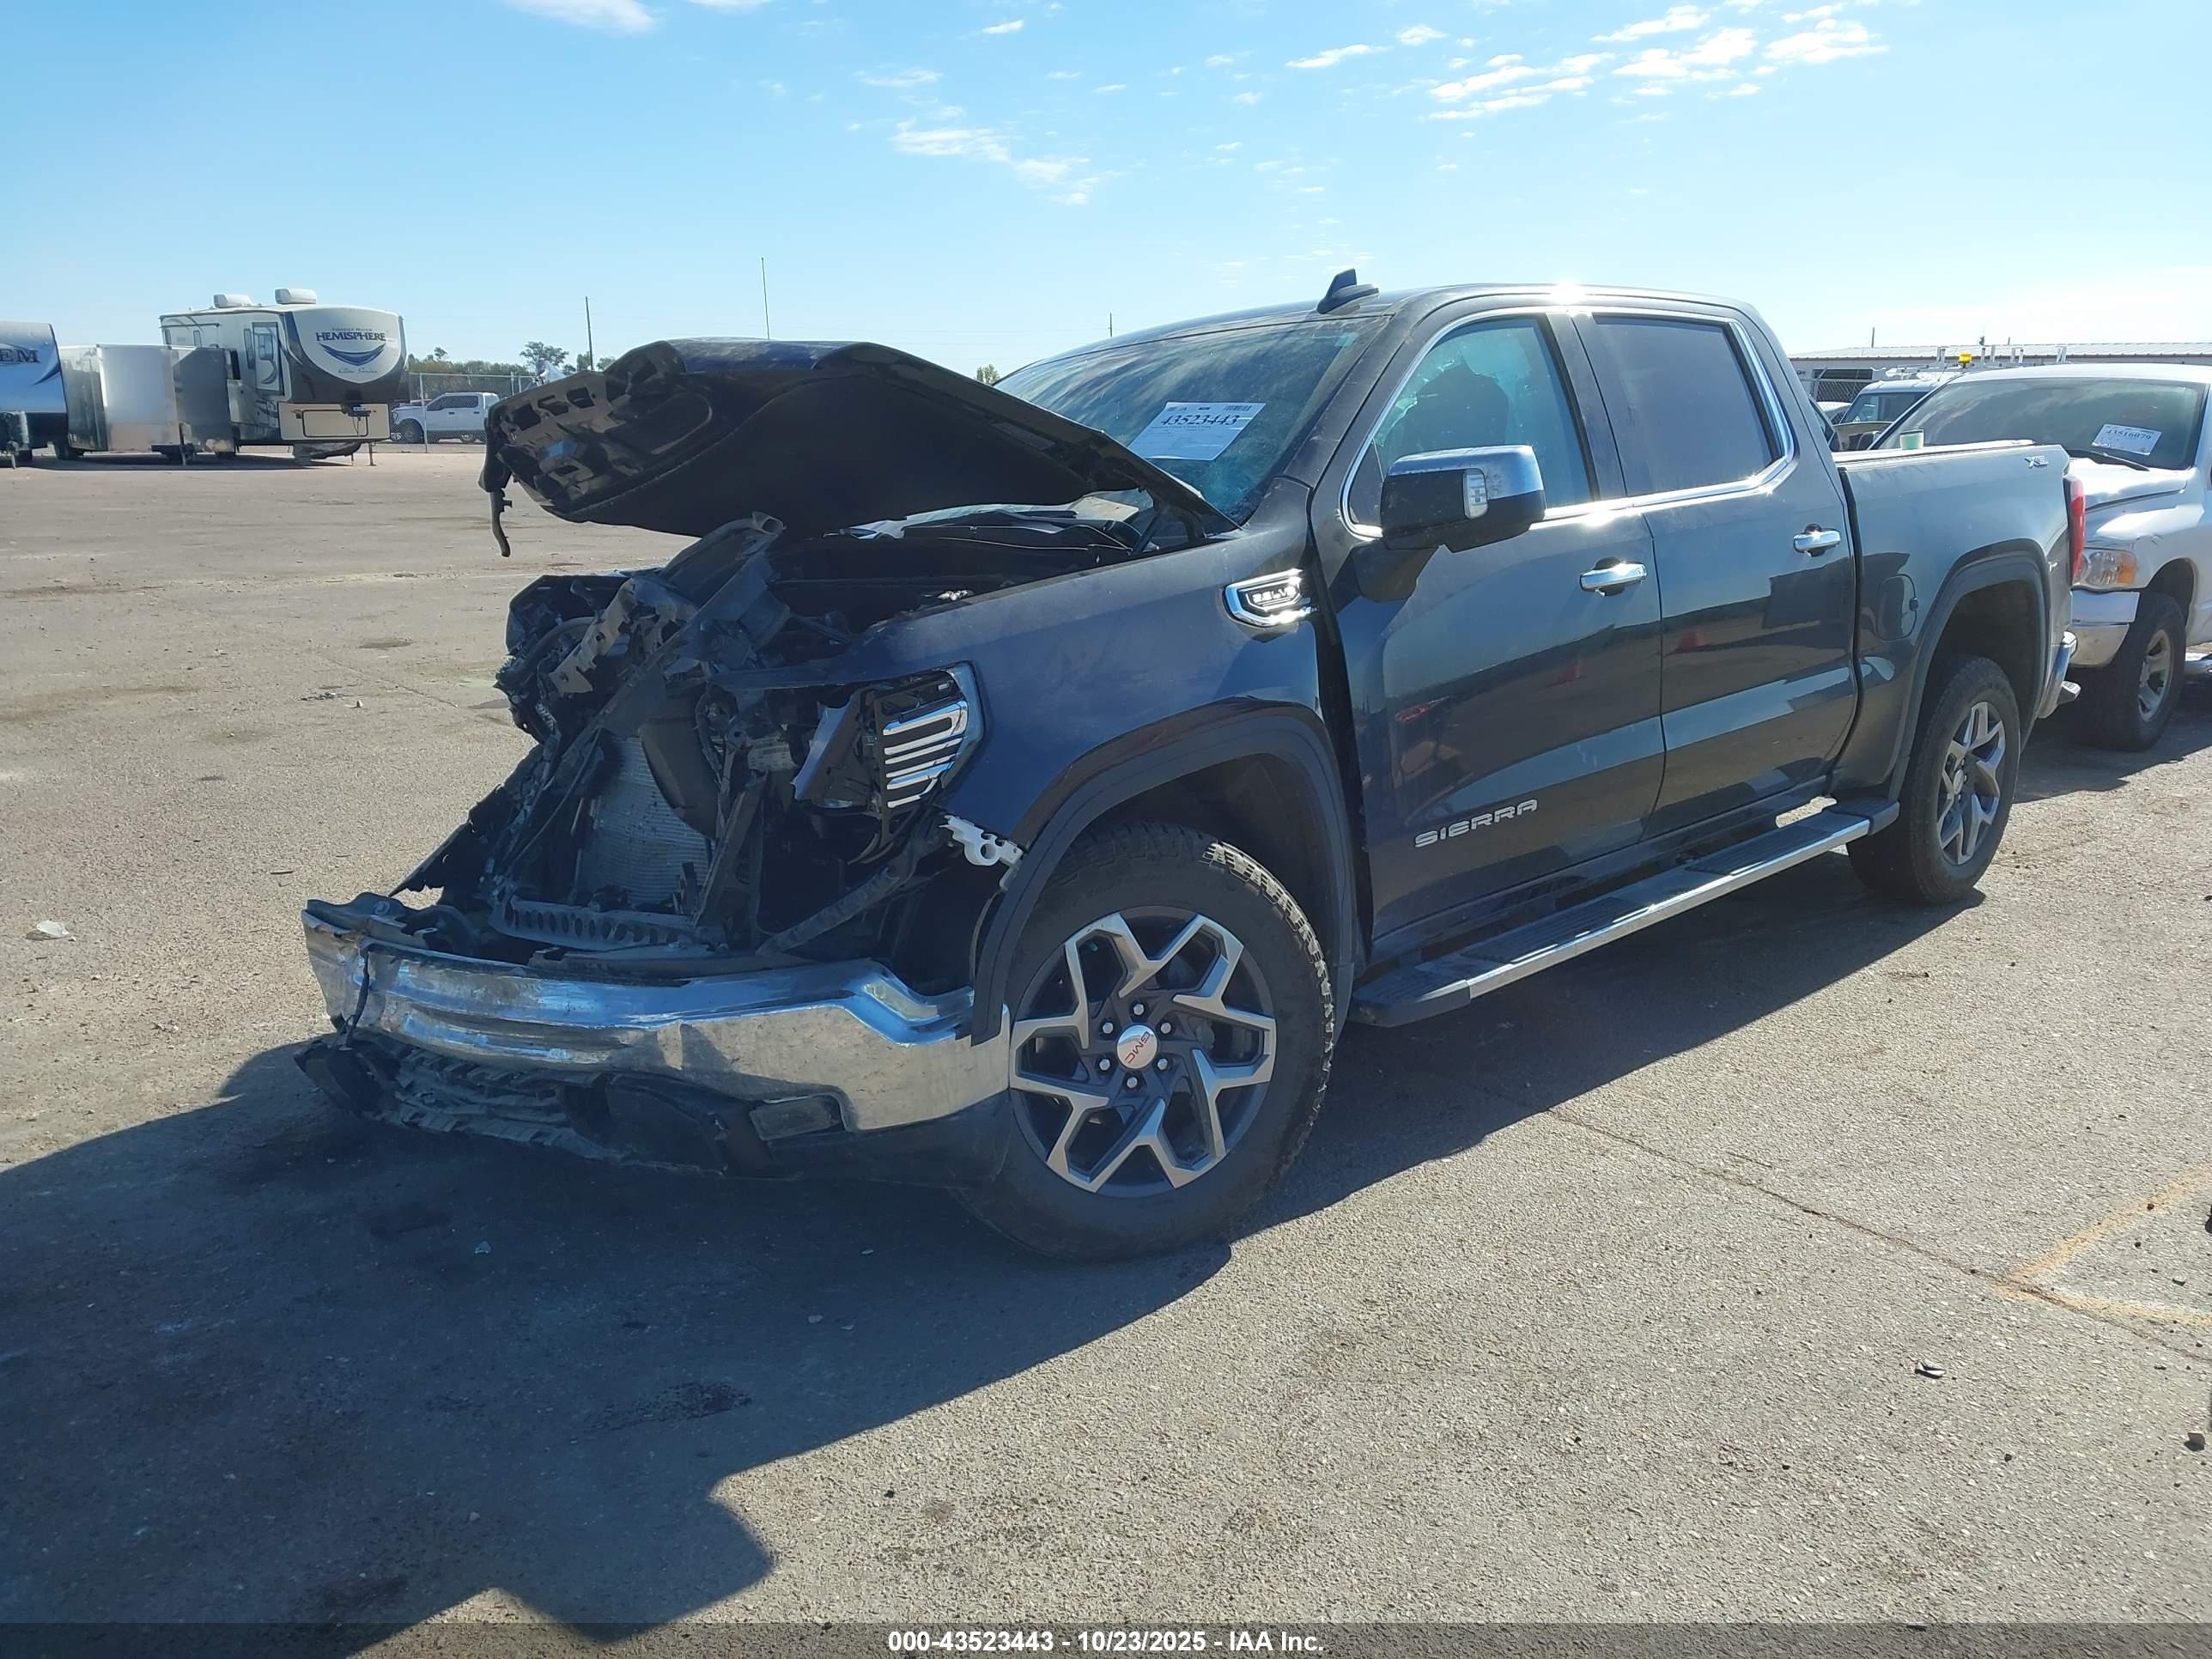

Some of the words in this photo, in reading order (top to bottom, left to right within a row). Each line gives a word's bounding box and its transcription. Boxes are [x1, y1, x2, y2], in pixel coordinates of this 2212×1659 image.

[315, 331, 386, 341] HEMISPHERE
[1160, 414, 1240, 426] 43523443
[1414, 799, 1538, 848] SIERRA
[1125, 1030, 1151, 1064] GMC
